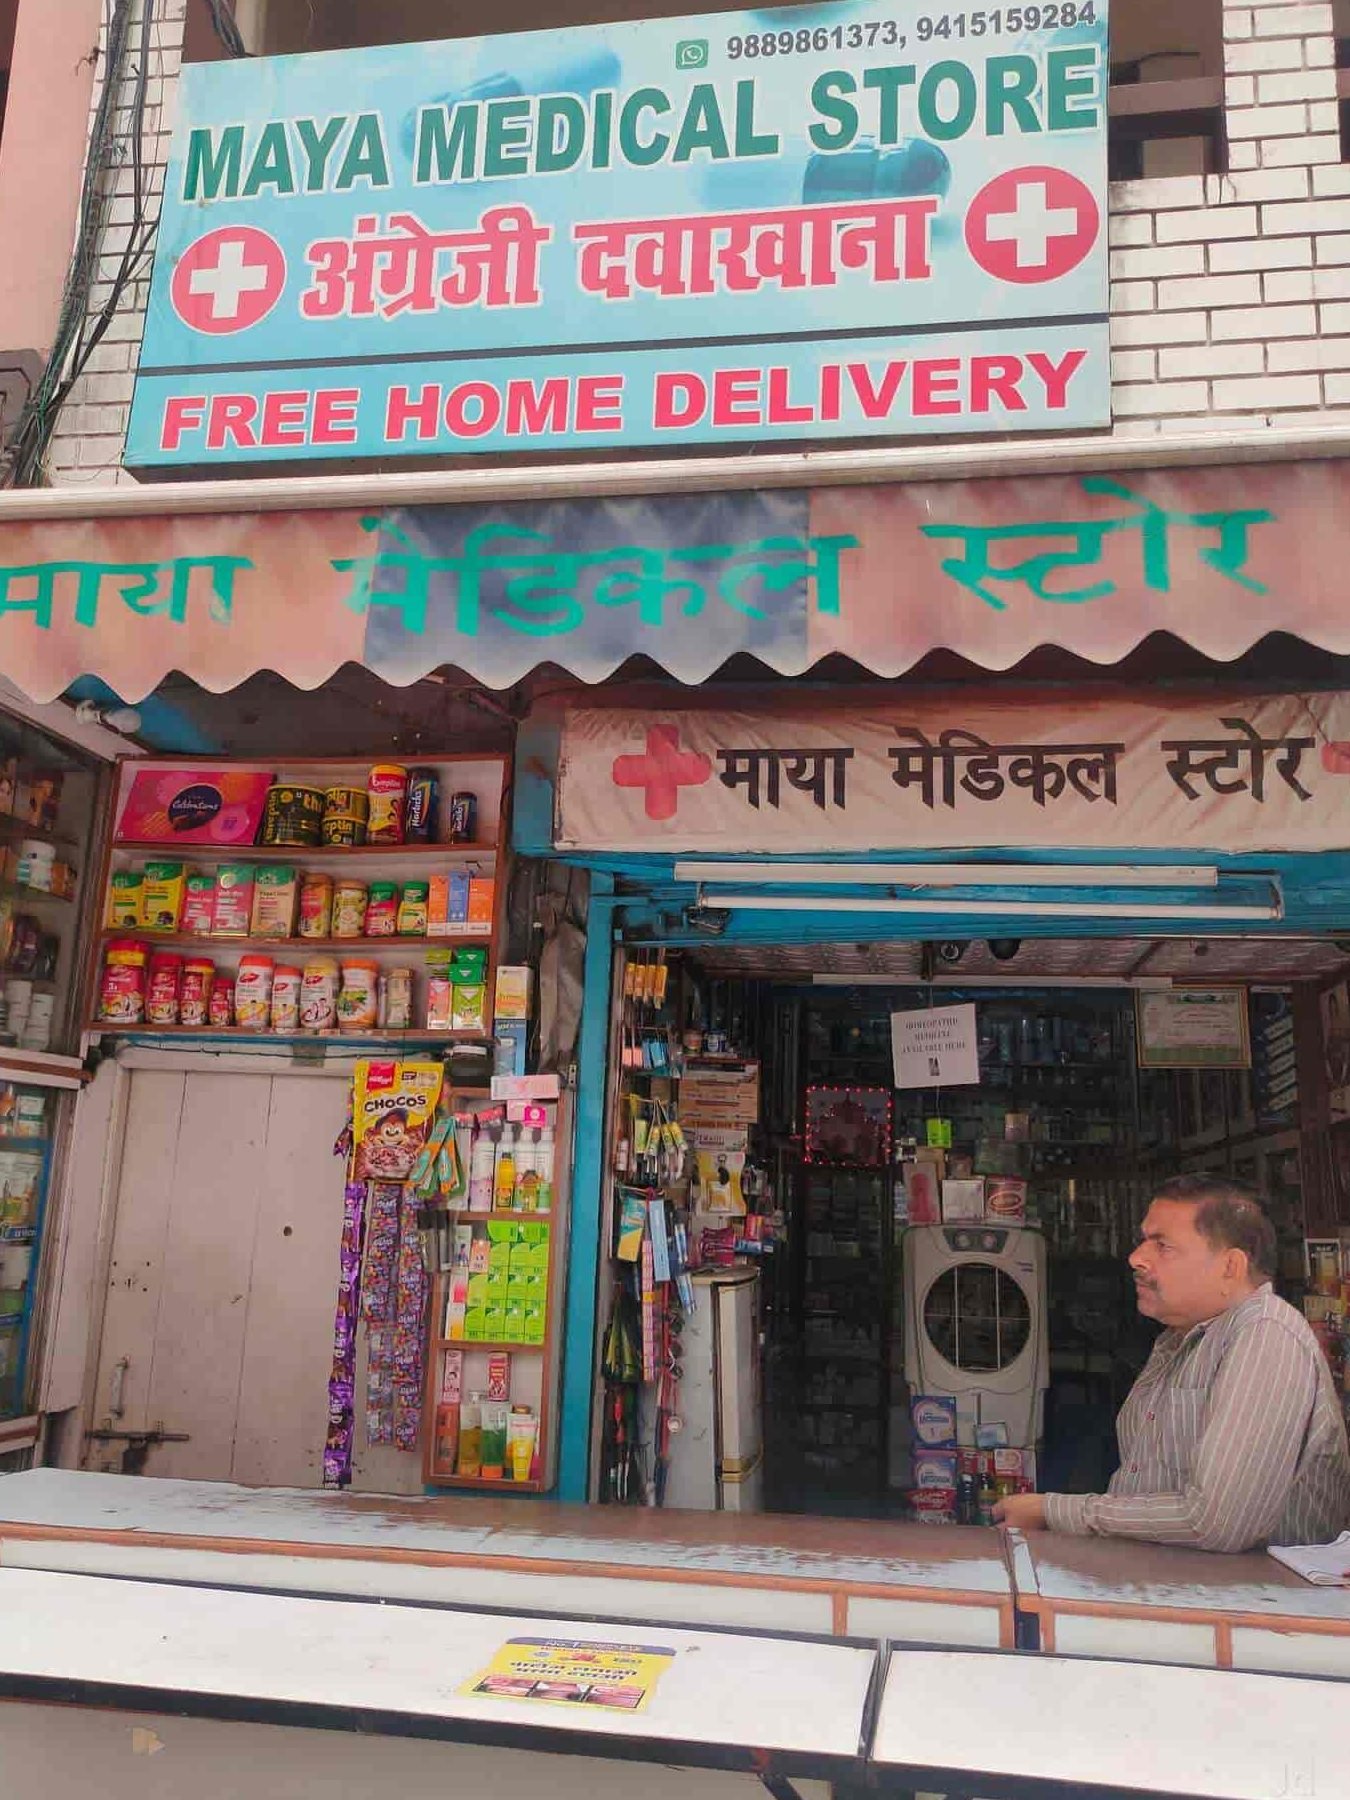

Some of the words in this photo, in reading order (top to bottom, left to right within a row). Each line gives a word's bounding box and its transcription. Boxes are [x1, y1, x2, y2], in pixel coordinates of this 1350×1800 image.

[727, 19, 906, 60] 9889861373,
[916, 1, 1096, 43] 9415159284
[182, 115, 390, 200] MAYA
[415, 80, 779, 183] MEDICAL
[808, 48, 1098, 150] STORE
[301, 206, 550, 320] अंग्रेजी
[160, 389, 359, 450] FREE
[385, 376, 623, 442] HOME
[653, 350, 1087, 429] DELIVERY
[0, 555, 252, 630] माया
[329, 515, 860, 636] मेडिकल
[920, 477, 1277, 611] स्टोर
[715, 747, 854, 811] माया
[889, 726, 1125, 809] मेडिकल
[1159, 717, 1316, 803] स्टोर
[364, 1095, 427, 1113] CHOCOS
